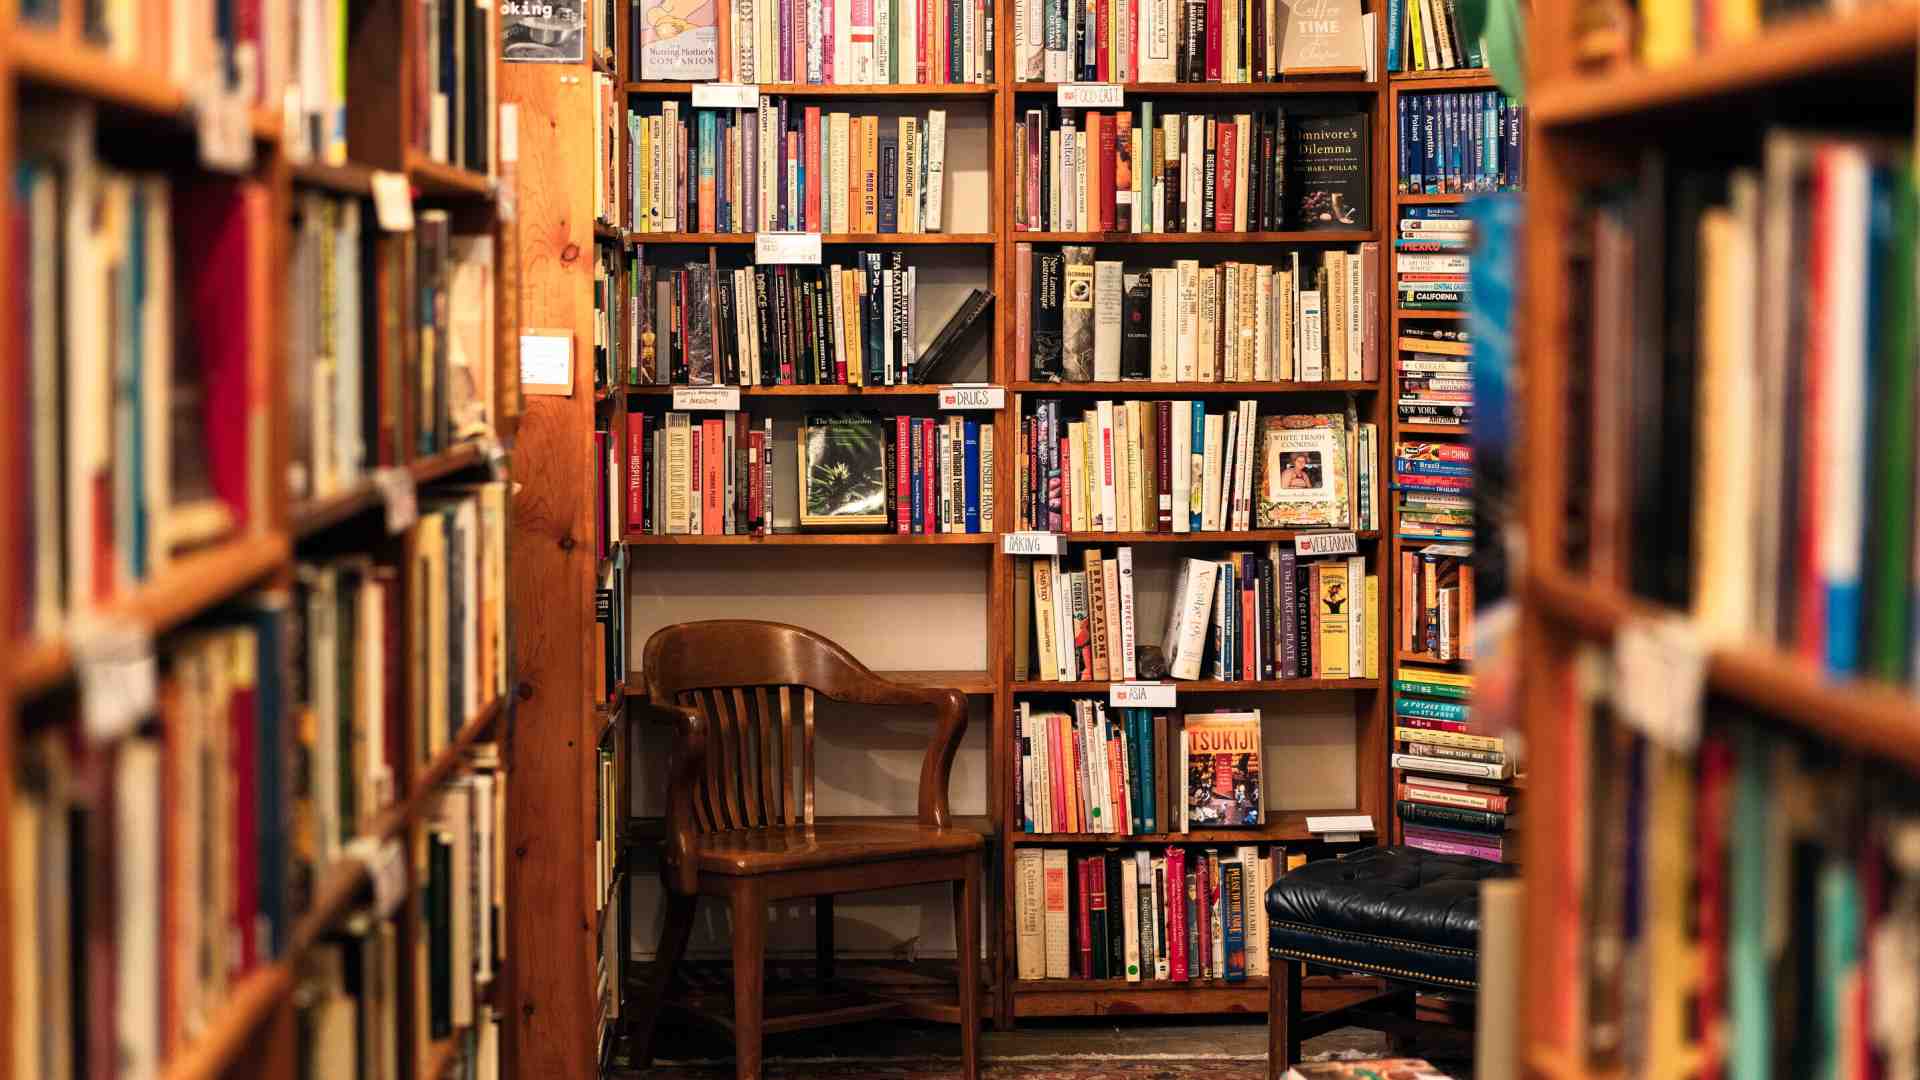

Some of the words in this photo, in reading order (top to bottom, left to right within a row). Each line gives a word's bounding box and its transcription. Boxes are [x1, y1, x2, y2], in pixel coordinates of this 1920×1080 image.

[1293, 20, 1336, 33] TIME
[761, 96, 769, 132] ANATOMY
[905, 121, 914, 151] RELIGION
[1411, 114, 1419, 142] Poland
[1425, 114, 1434, 159] Argentina
[1509, 119, 1519, 147] Turkey
[905, 151, 914, 165] AND
[1063, 133, 1074, 167] Salted
[905, 166, 914, 197] MEDICINE
[1205, 154, 1215, 200] RESTAURANT
[1205, 200, 1215, 218] MAN
[1403, 242, 1440, 252] MEXICO
[755, 273, 769, 309] DANCE
[892, 256, 902, 333] TAKAMIYAMA
[1416, 292, 1458, 301] CALIFORNIA
[957, 390, 989, 407] DRUGS
[1400, 406, 1416, 415] NEW
[1417, 406, 1438, 415] YORK
[815, 417, 829, 425] The
[830, 417, 850, 425] Secret
[851, 417, 872, 425] Garden
[670, 433, 688, 446] AND
[670, 448, 688, 462] THE
[951, 440, 963, 476] marijuana
[630, 455, 641, 490] HOSPITAL
[670, 464, 688, 482] BAND
[982, 450, 993, 493] INVISIBLE
[670, 485, 688, 509] PLAYED
[952, 478, 964, 524] reconsidered
[982, 494, 993, 521] HAND
[1009, 535, 1040, 553] BAKING
[1310, 533, 1355, 553] VEGETARIAN
[1073, 582, 1083, 611] COOKIES
[1093, 569, 1103, 612] BREAD
[1124, 594, 1132, 630] PERFECT
[1096, 617, 1106, 659] ALONE
[1299, 587, 1309, 665] Vegetarianism
[1128, 687, 1147, 700] ASIA
[1189, 730, 1254, 751] TSUKIJI
[1231, 868, 1241, 890] PLEASE
[1231, 900, 1241, 911] THE
